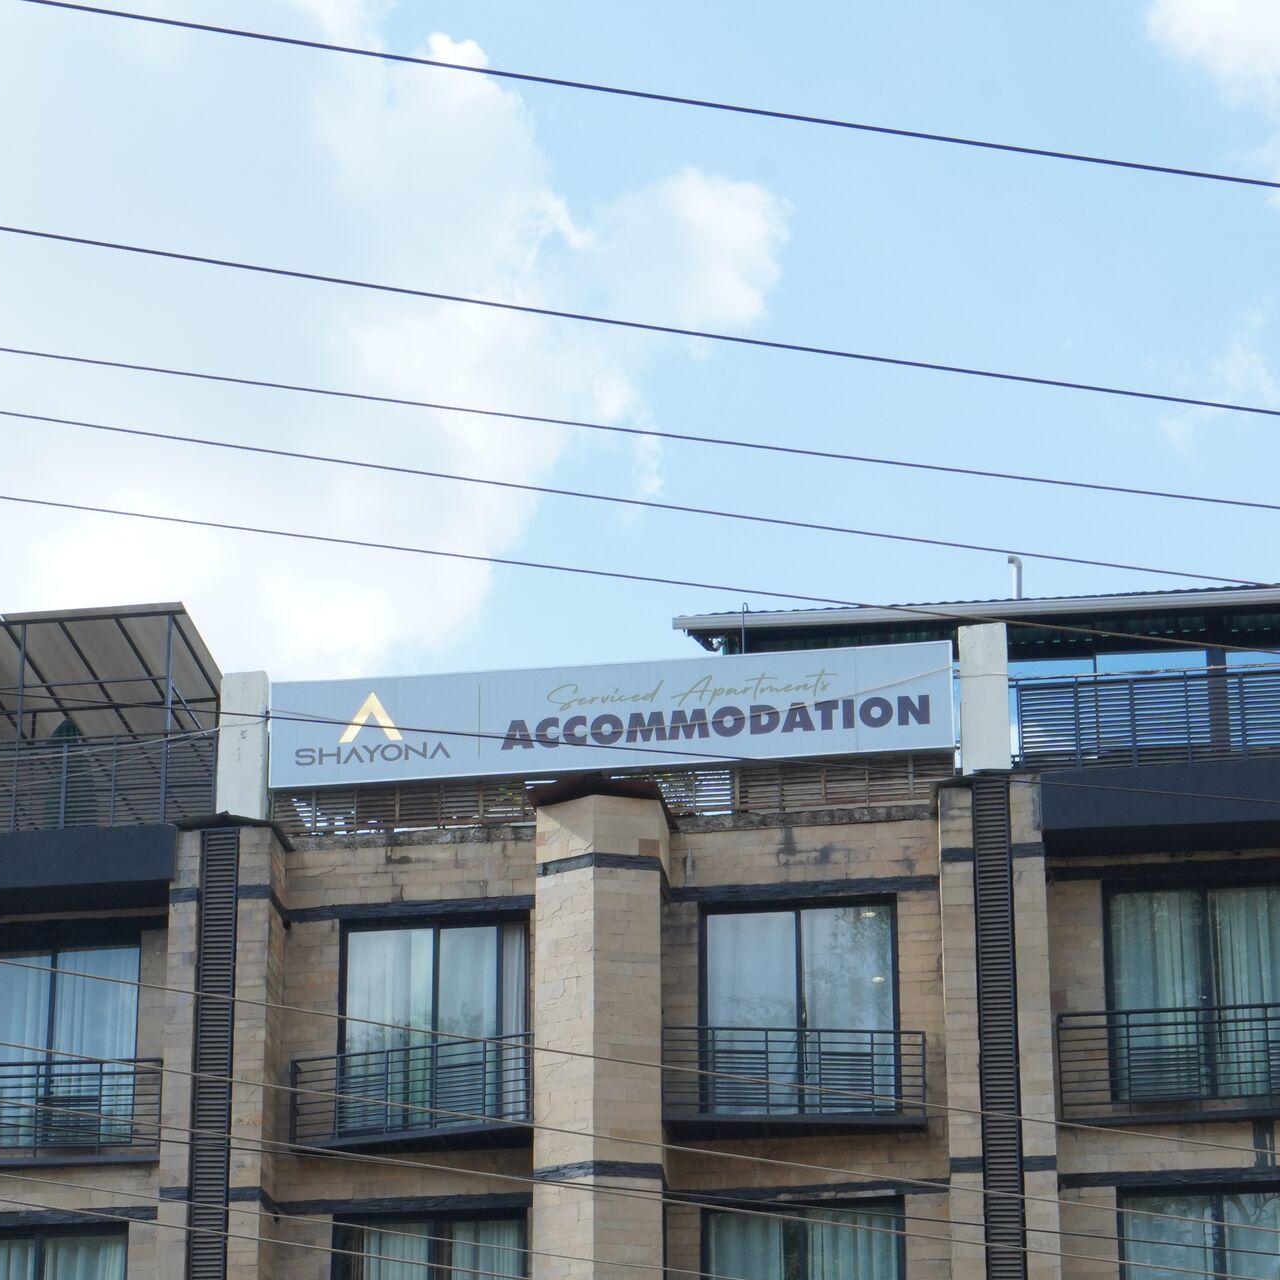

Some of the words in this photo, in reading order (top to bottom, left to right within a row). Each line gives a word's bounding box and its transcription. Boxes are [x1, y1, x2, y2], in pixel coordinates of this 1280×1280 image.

[546, 680, 665, 711] Serviced
[670, 669, 839, 708] Apartments
[501, 695, 931, 750] ACCOMMODATION
[295, 741, 451, 767] SHAYONA
